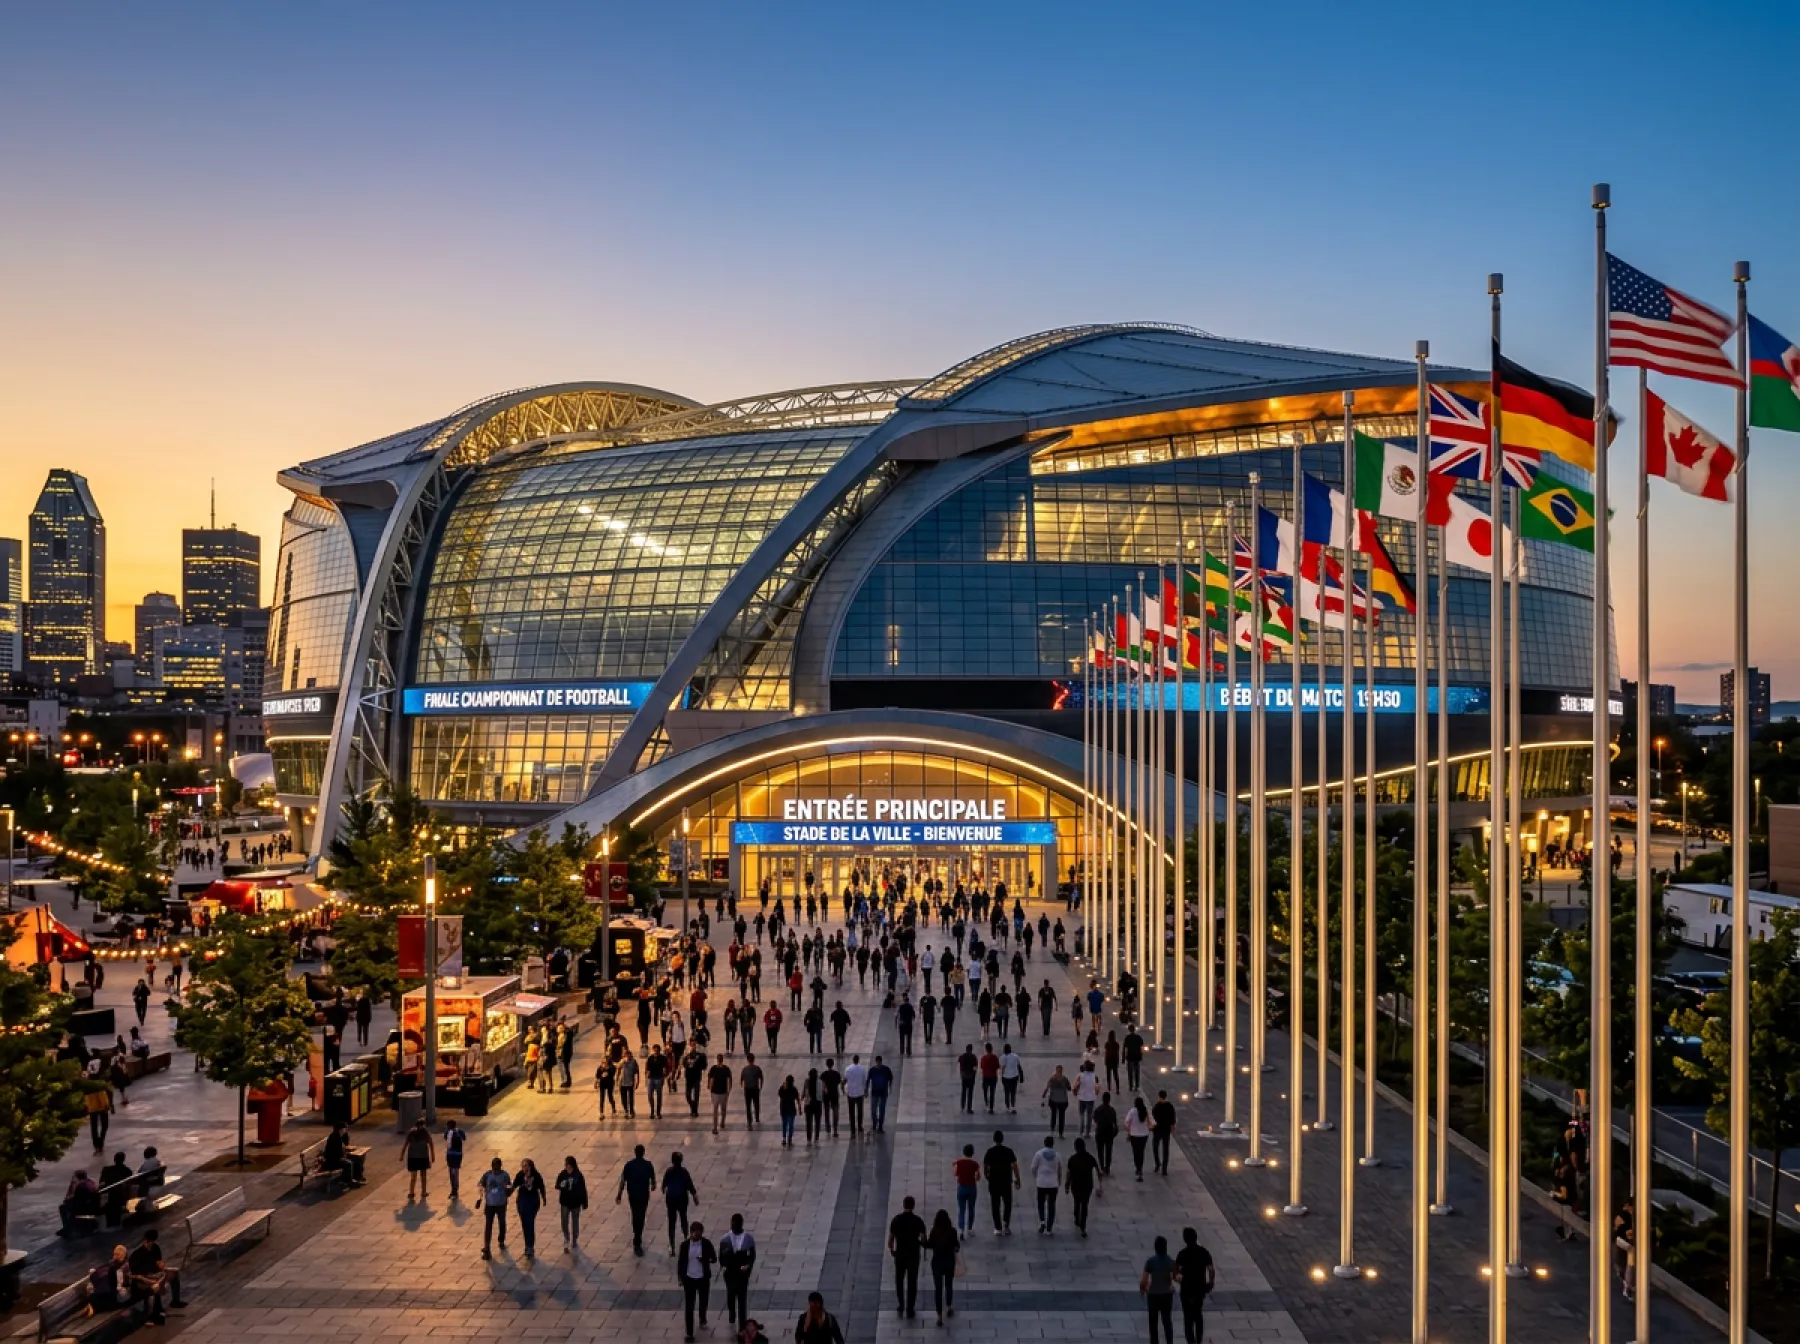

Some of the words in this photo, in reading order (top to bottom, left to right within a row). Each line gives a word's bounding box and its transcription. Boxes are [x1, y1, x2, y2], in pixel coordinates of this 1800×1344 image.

[546, 689, 563, 706] DE
[565, 688, 632, 706] FOOTBALL
[783, 793, 868, 820] ENTRÉE
[875, 799, 1006, 820] PRINCIPALE
[783, 826, 828, 841] STADE
[852, 826, 870, 841] LA
[872, 826, 912, 841] VILLE
